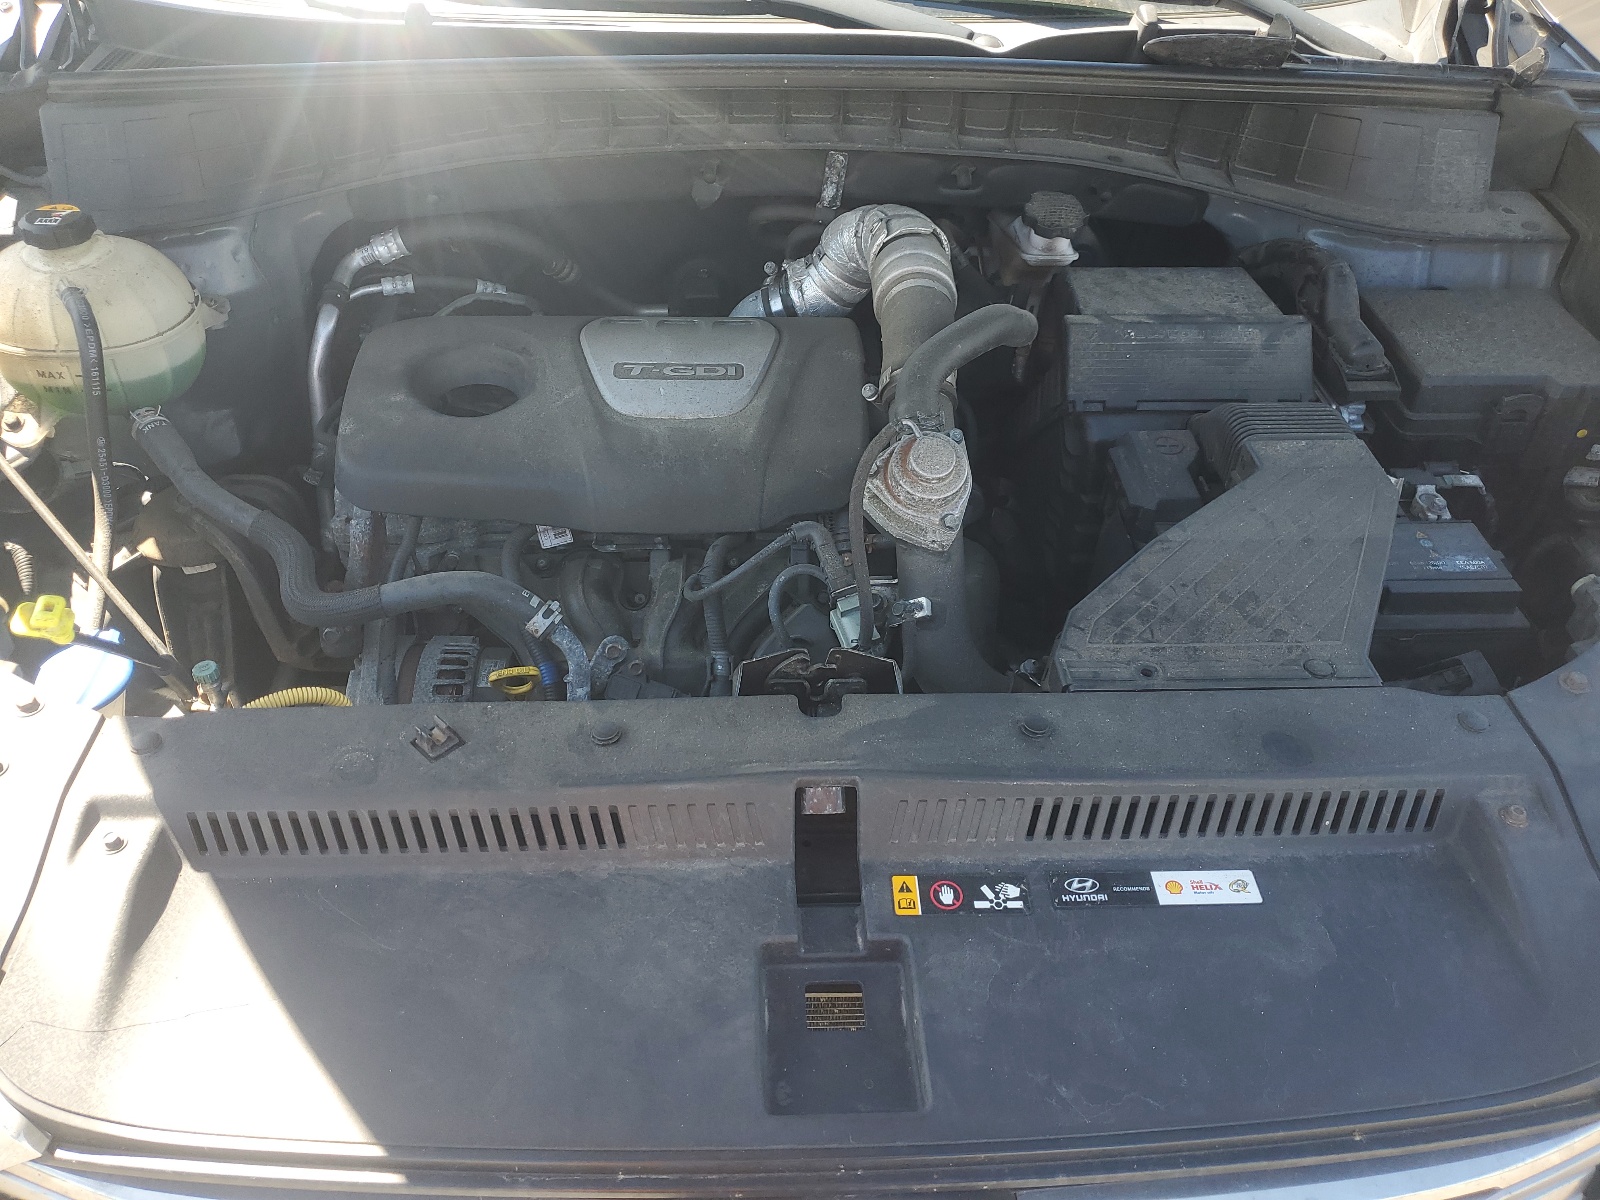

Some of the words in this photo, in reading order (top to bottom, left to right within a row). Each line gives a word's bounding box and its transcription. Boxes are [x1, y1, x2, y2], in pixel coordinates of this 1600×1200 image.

[36, 369, 66, 380] MAX
[623, 364, 737, 377] T-GDI
[1190, 882, 1223, 891] HELIX
[1061, 893, 1109, 902] HYUNDAI
